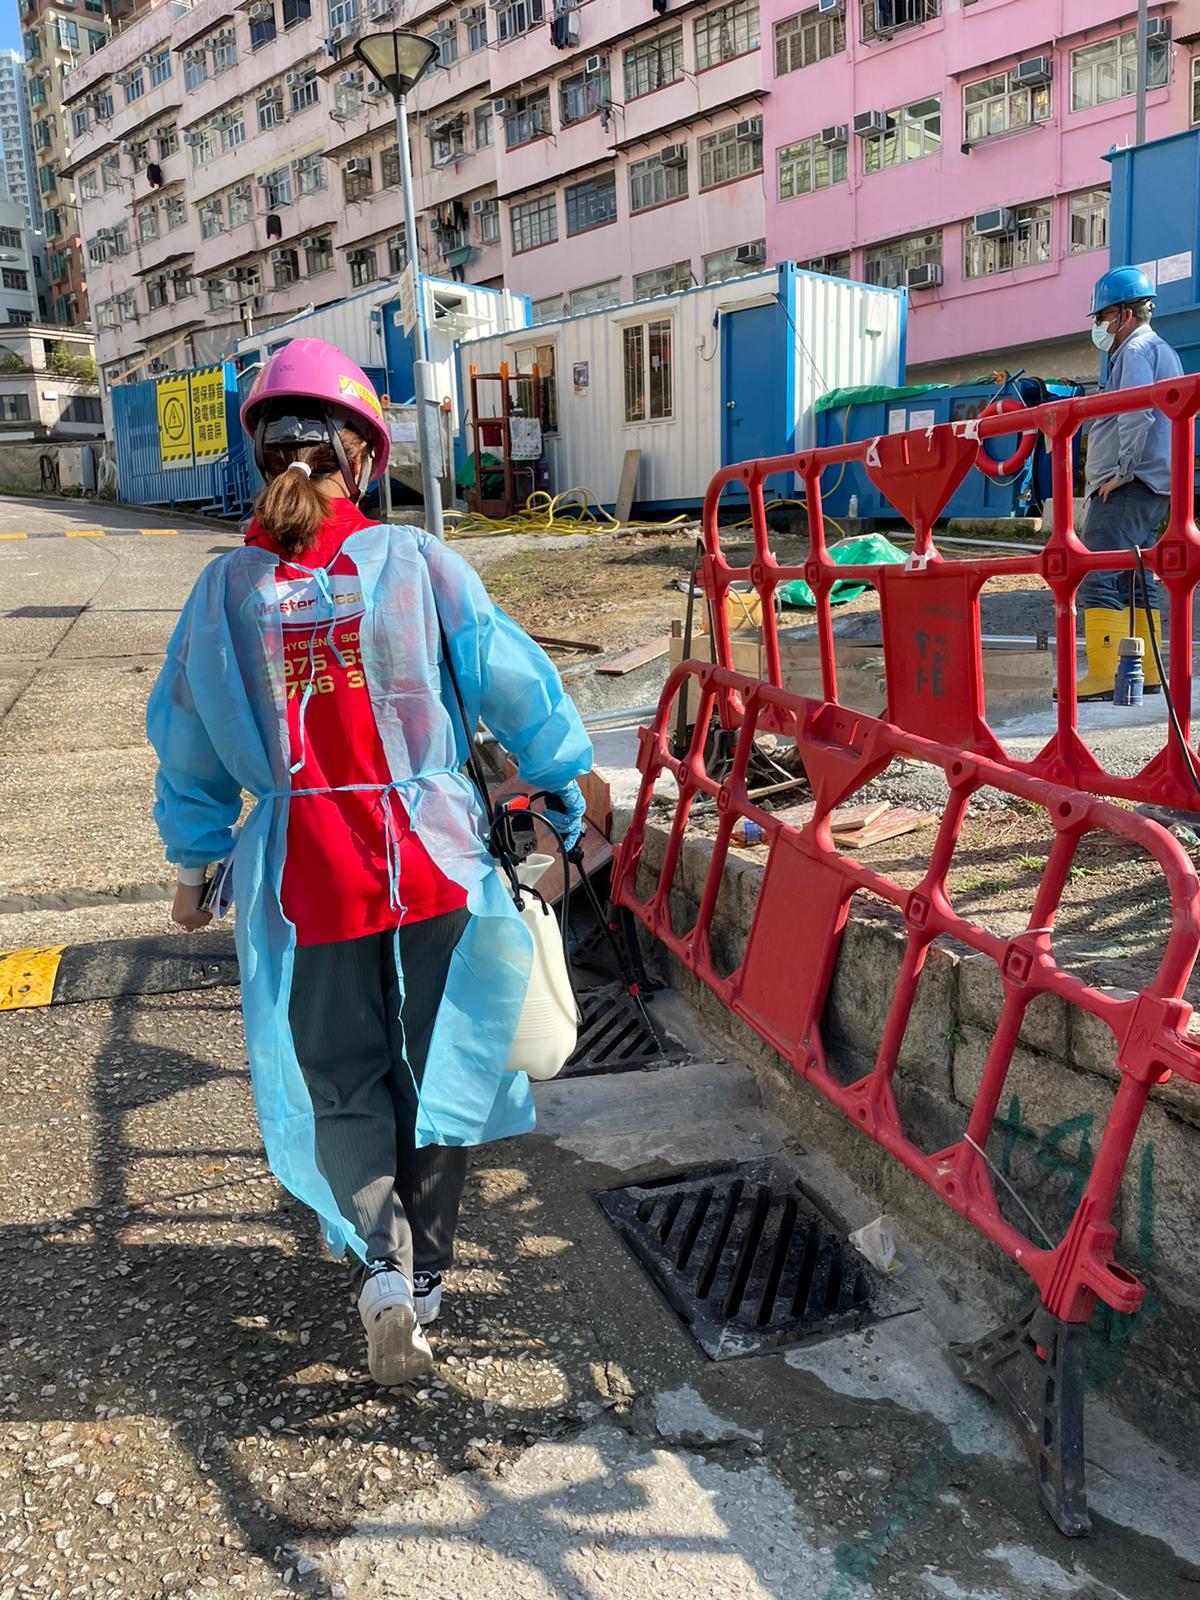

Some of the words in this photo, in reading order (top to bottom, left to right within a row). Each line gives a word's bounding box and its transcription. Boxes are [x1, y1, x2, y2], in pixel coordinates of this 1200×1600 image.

[253, 592, 362, 616] Masterlean
[340, 631, 361, 643] SO
[269, 675, 335, 704] 756
